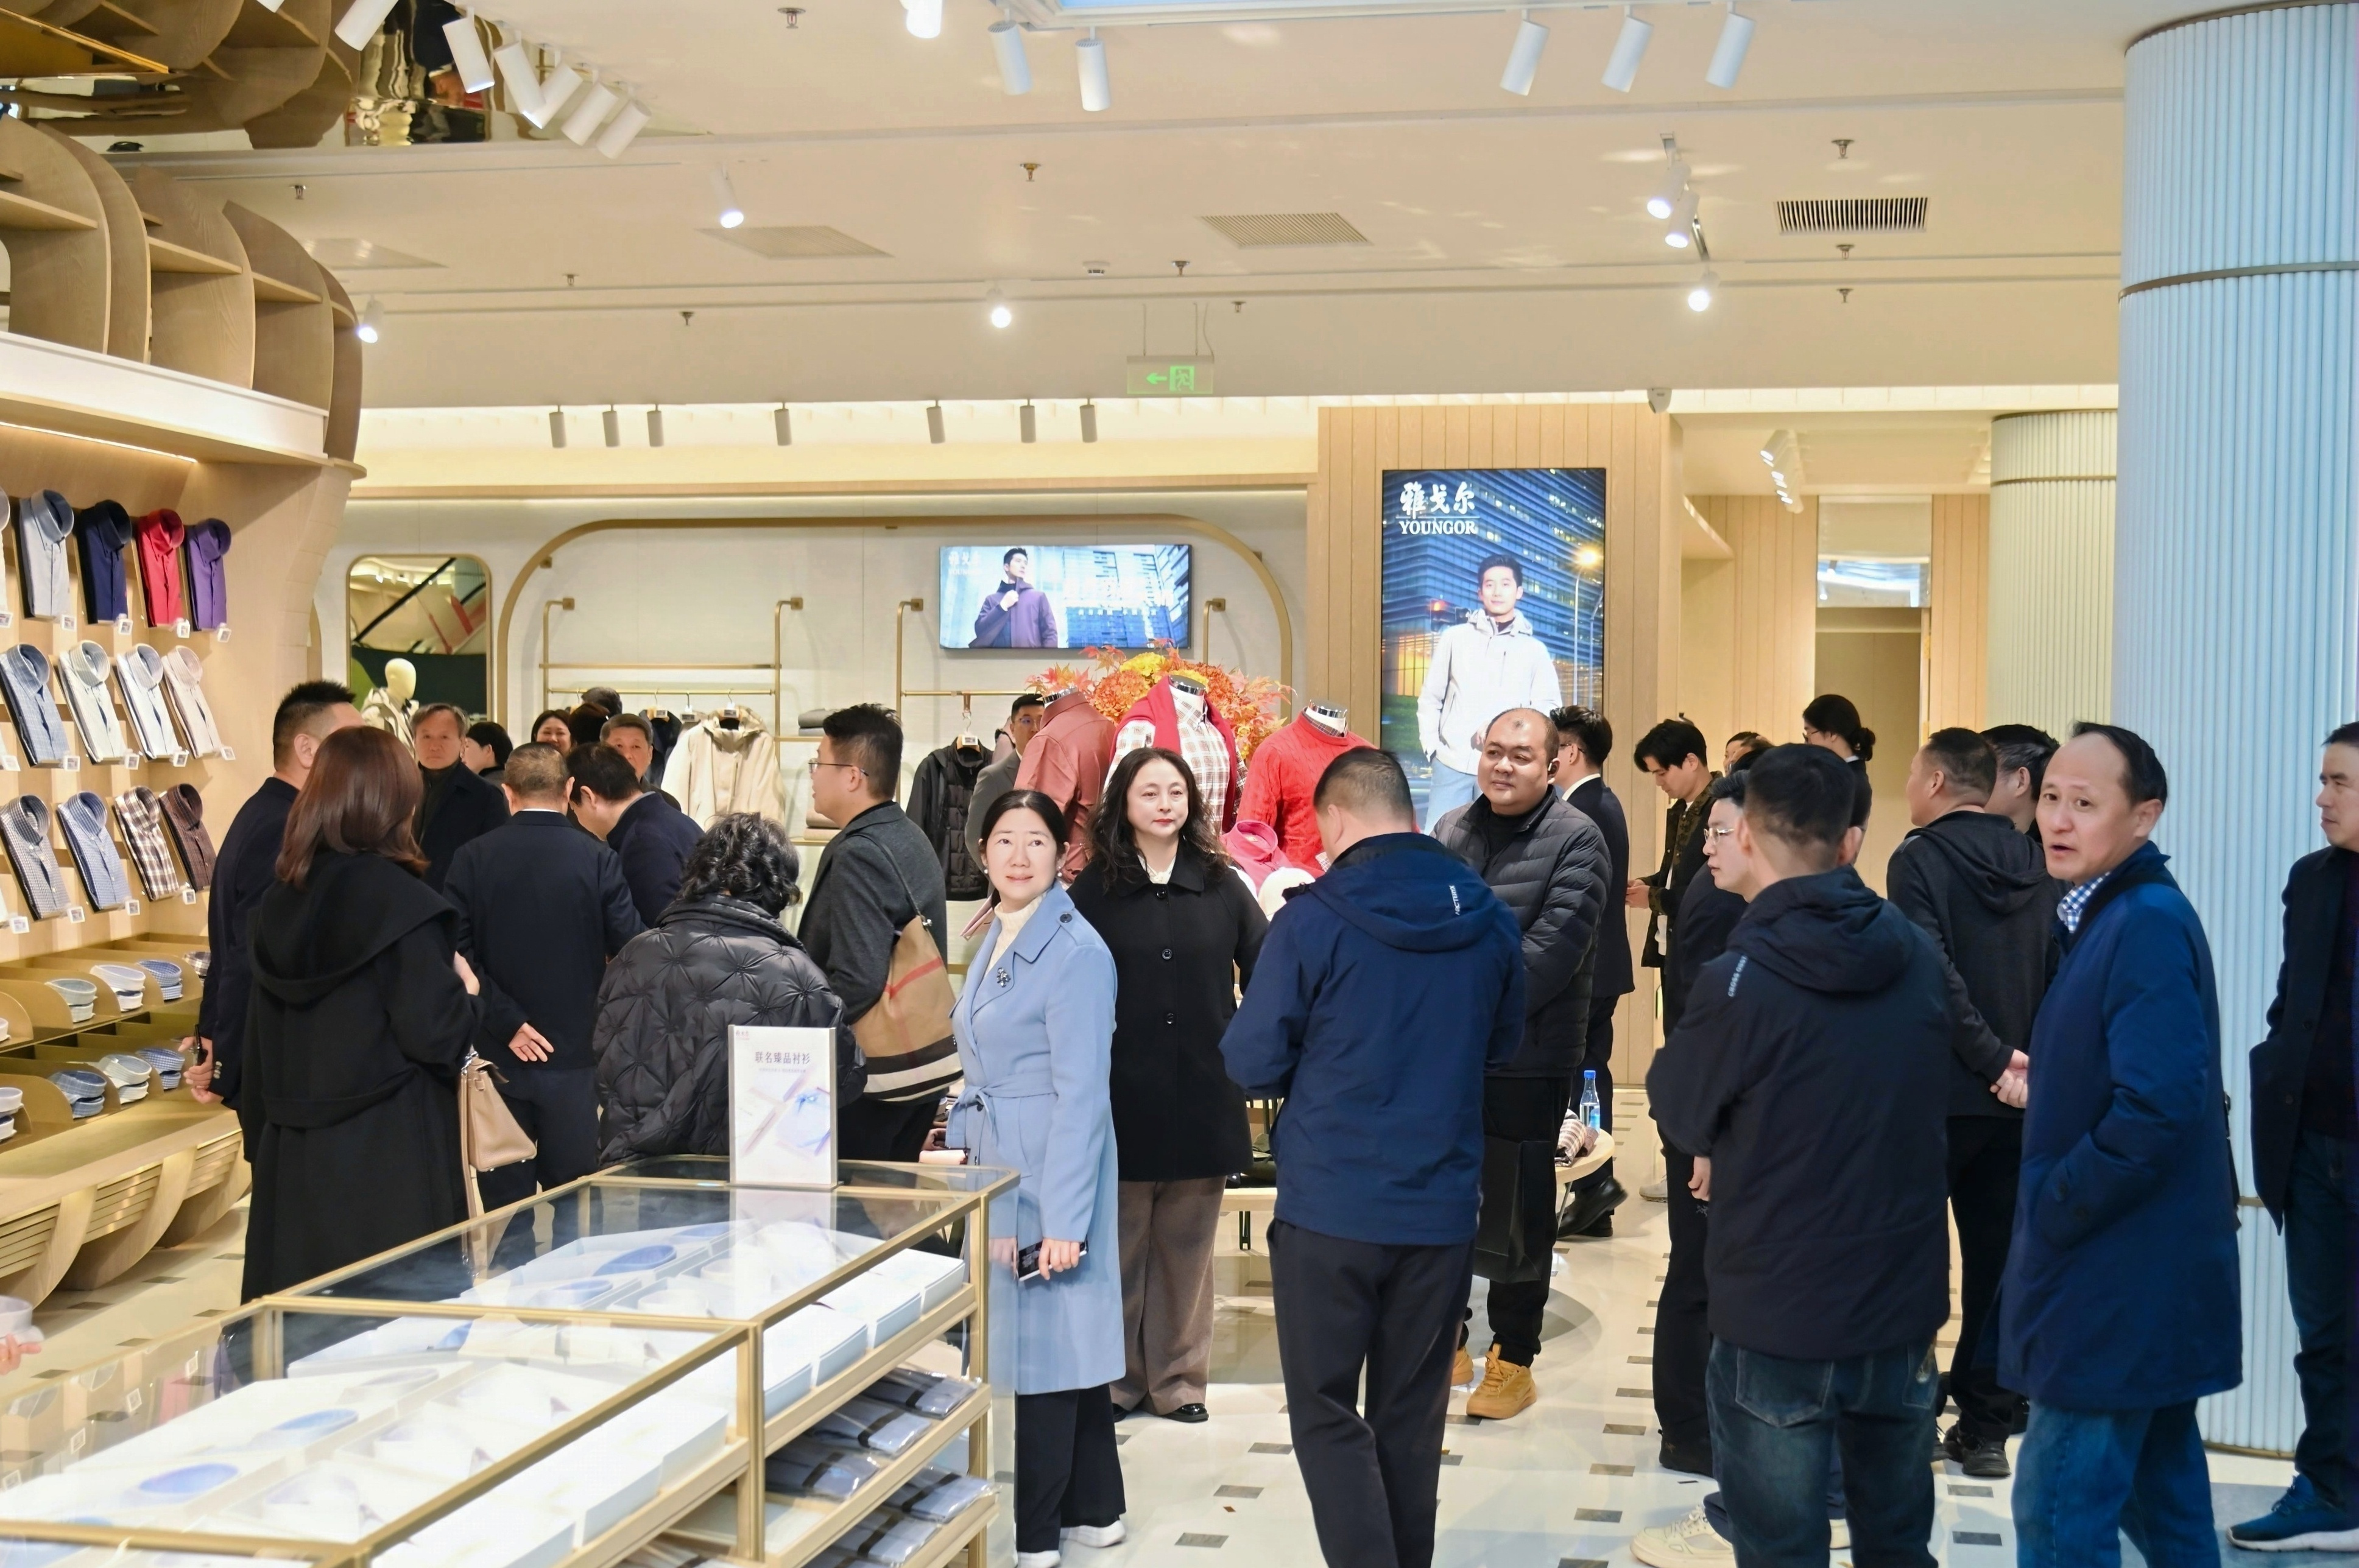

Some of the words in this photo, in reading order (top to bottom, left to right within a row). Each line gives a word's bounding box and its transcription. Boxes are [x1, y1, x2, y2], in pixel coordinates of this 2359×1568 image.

[1400, 481, 1475, 519] 雅戈尔
[1399, 520, 1479, 535] YOUNGOR
[755, 1052, 810, 1064] 联名臻品衬衫
